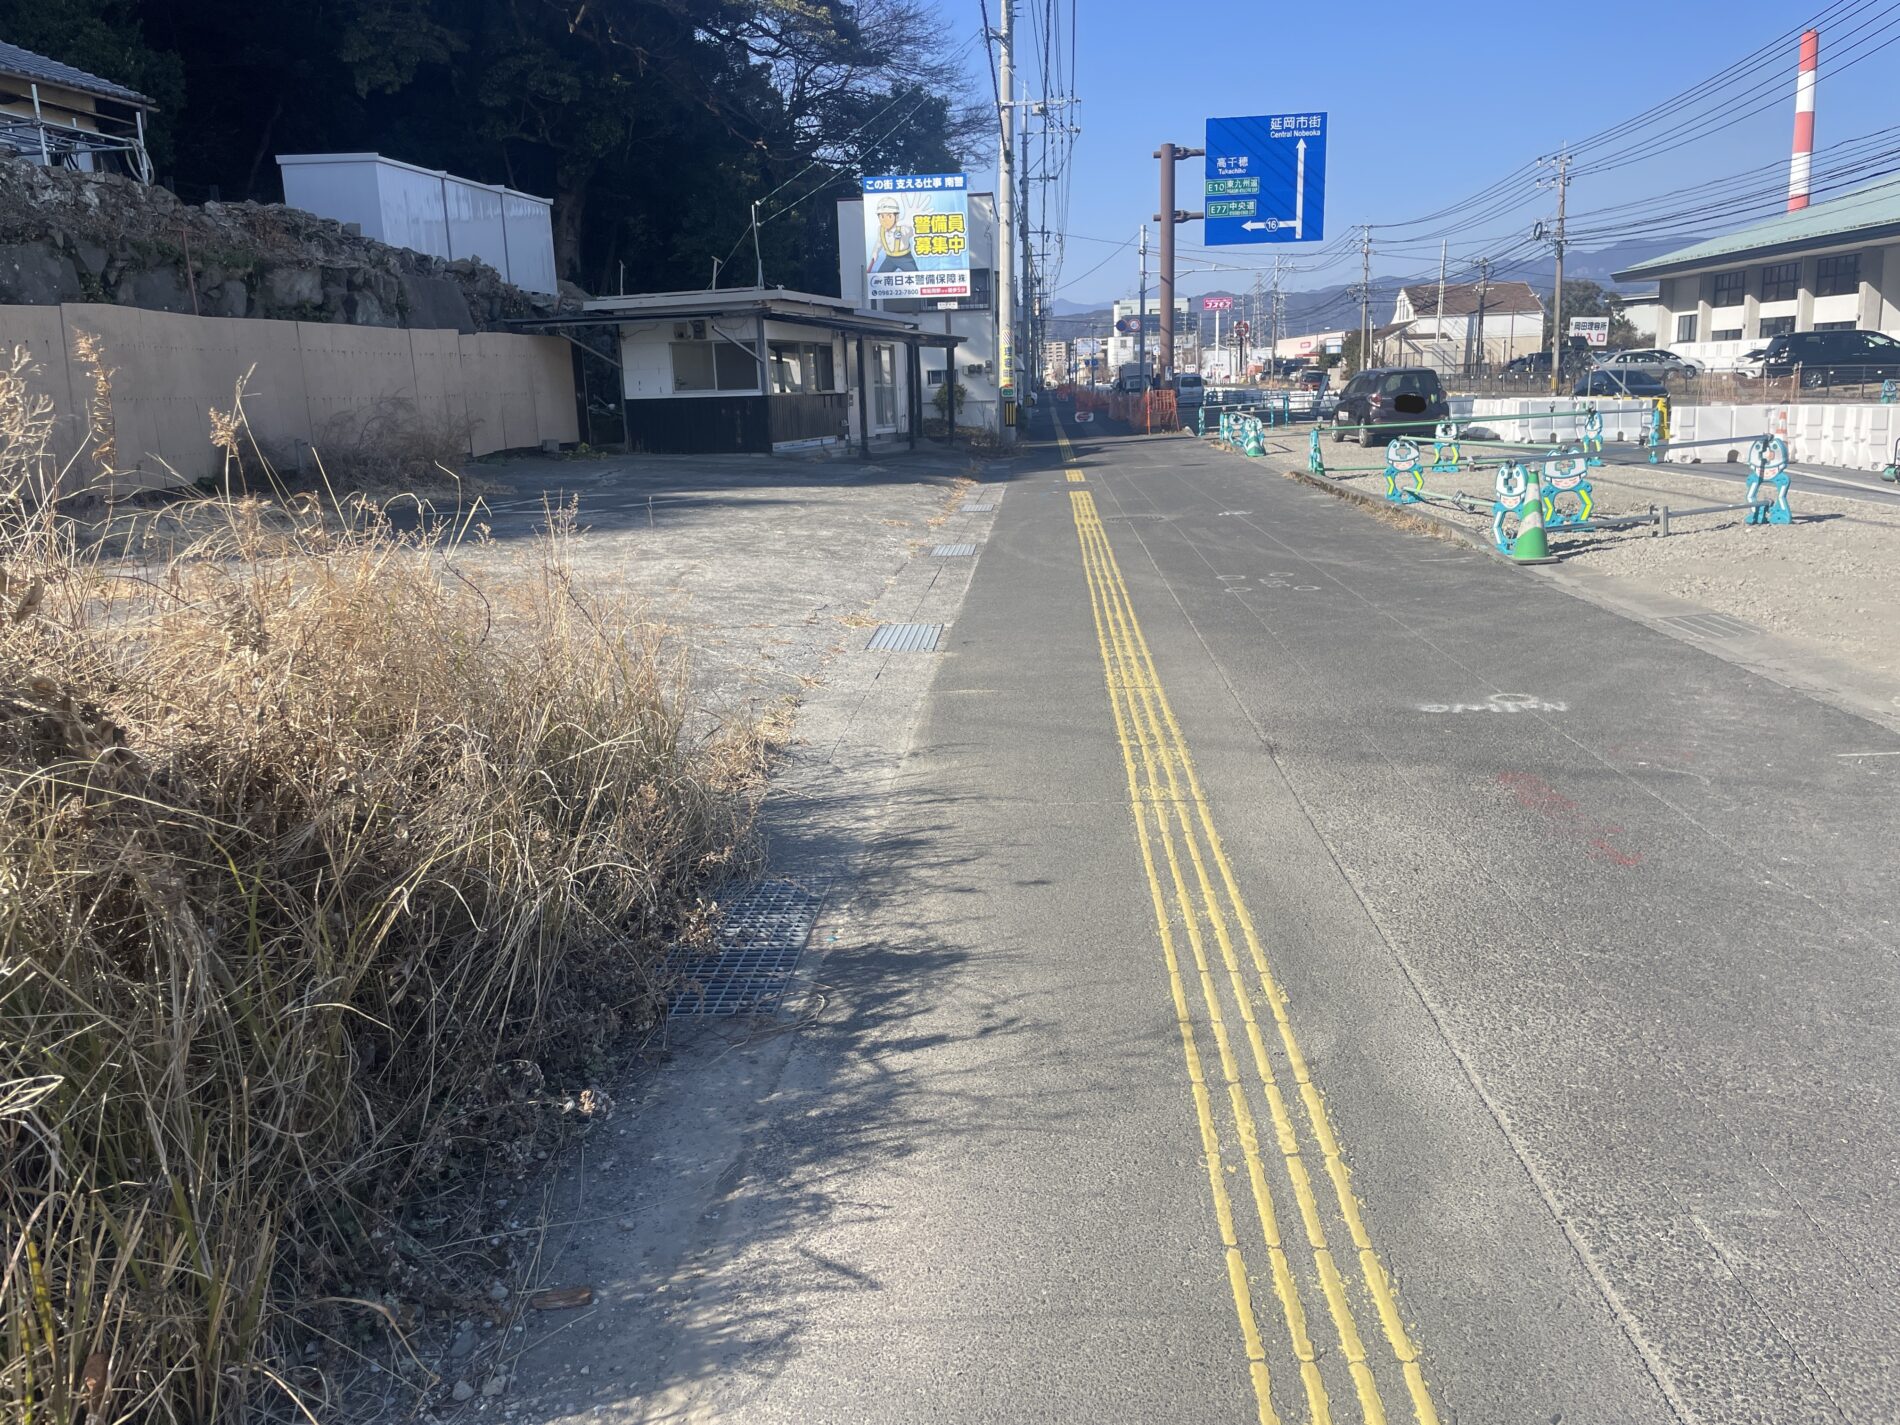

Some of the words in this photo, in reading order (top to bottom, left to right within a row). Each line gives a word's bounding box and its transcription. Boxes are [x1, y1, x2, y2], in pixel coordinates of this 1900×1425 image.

[1270, 116, 1321, 130] 延岡市街
[1216, 156, 1248, 168] 高千穂
[865, 179, 893, 190] この街
[895, 177, 942, 189] 支える仕事
[1208, 183, 1225, 192] E10
[1226, 179, 1258, 188] 東九州道
[1210, 205, 1227, 214] E77
[1229, 201, 1255, 210] 中央道
[913, 213, 965, 234] 警備員
[1267, 221, 1276, 229] 16
[914, 234, 966, 255] 募集中
[883, 274, 957, 286] 南日本警備保障
